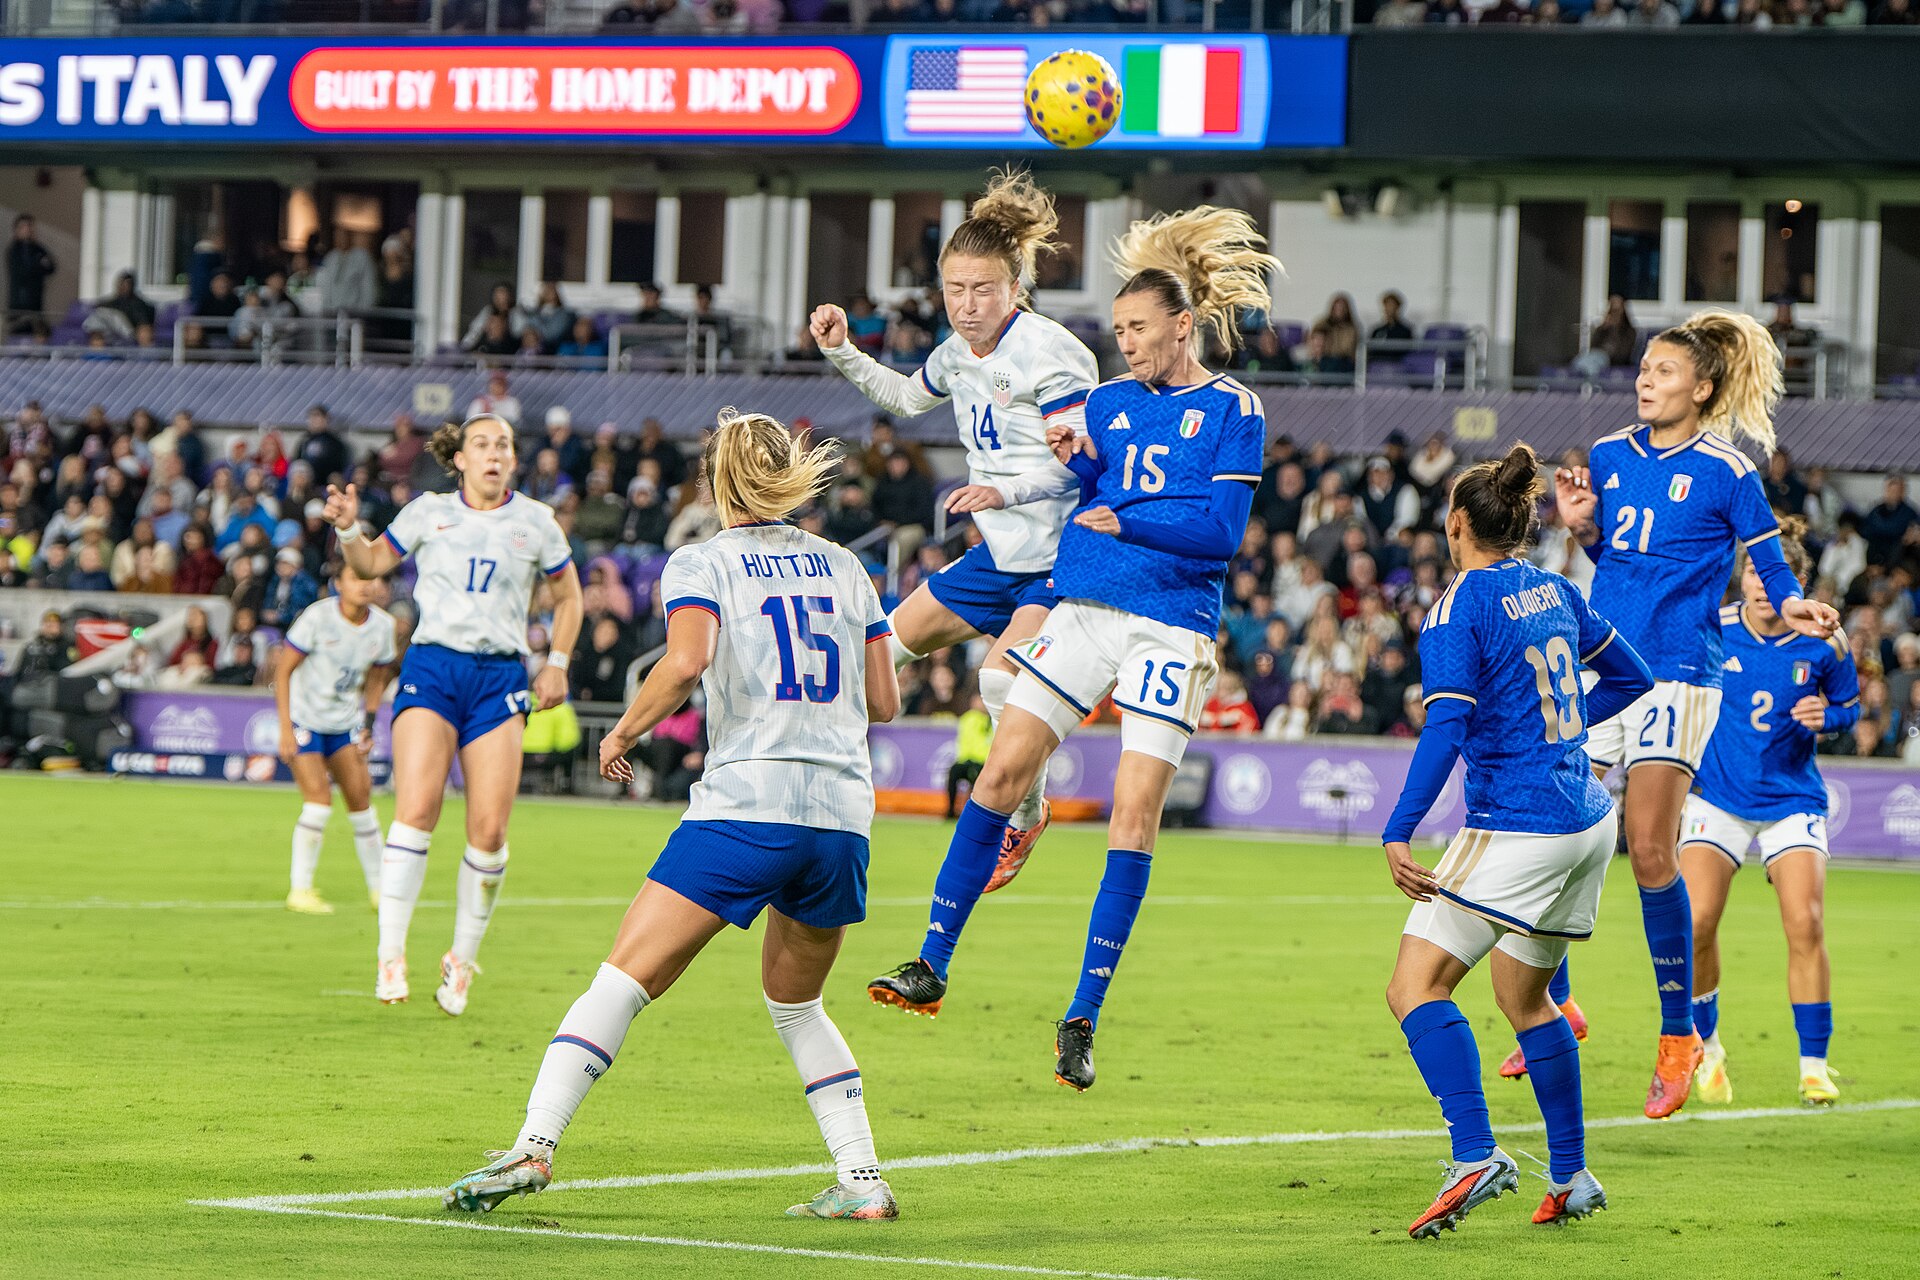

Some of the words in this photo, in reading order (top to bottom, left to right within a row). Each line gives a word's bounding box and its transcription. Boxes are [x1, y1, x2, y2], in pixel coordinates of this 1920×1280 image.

[56, 54, 278, 126] ITALY
[314, 69, 395, 110] BUILT
[395, 69, 436, 110] BY
[448, 66, 539, 112] THE
[549, 67, 677, 113] HOME
[686, 67, 836, 114] DEPOT
[971, 403, 1002, 450] 14
[1122, 444, 1170, 494] 15
[1611, 505, 1655, 554] 21
[465, 556, 497, 593] 17
[740, 552, 833, 579] HUTTON
[1501, 582, 1562, 621] OLIVIERO
[760, 595, 840, 704] 15
[504, 689, 532, 715] 17
[1139, 659, 1186, 707] 15
[1524, 636, 1583, 744] 13
[1639, 705, 1676, 748] 21
[1750, 690, 1774, 733] 2
[584, 1063, 601, 1082] USA
[846, 1087, 863, 1099] USA
